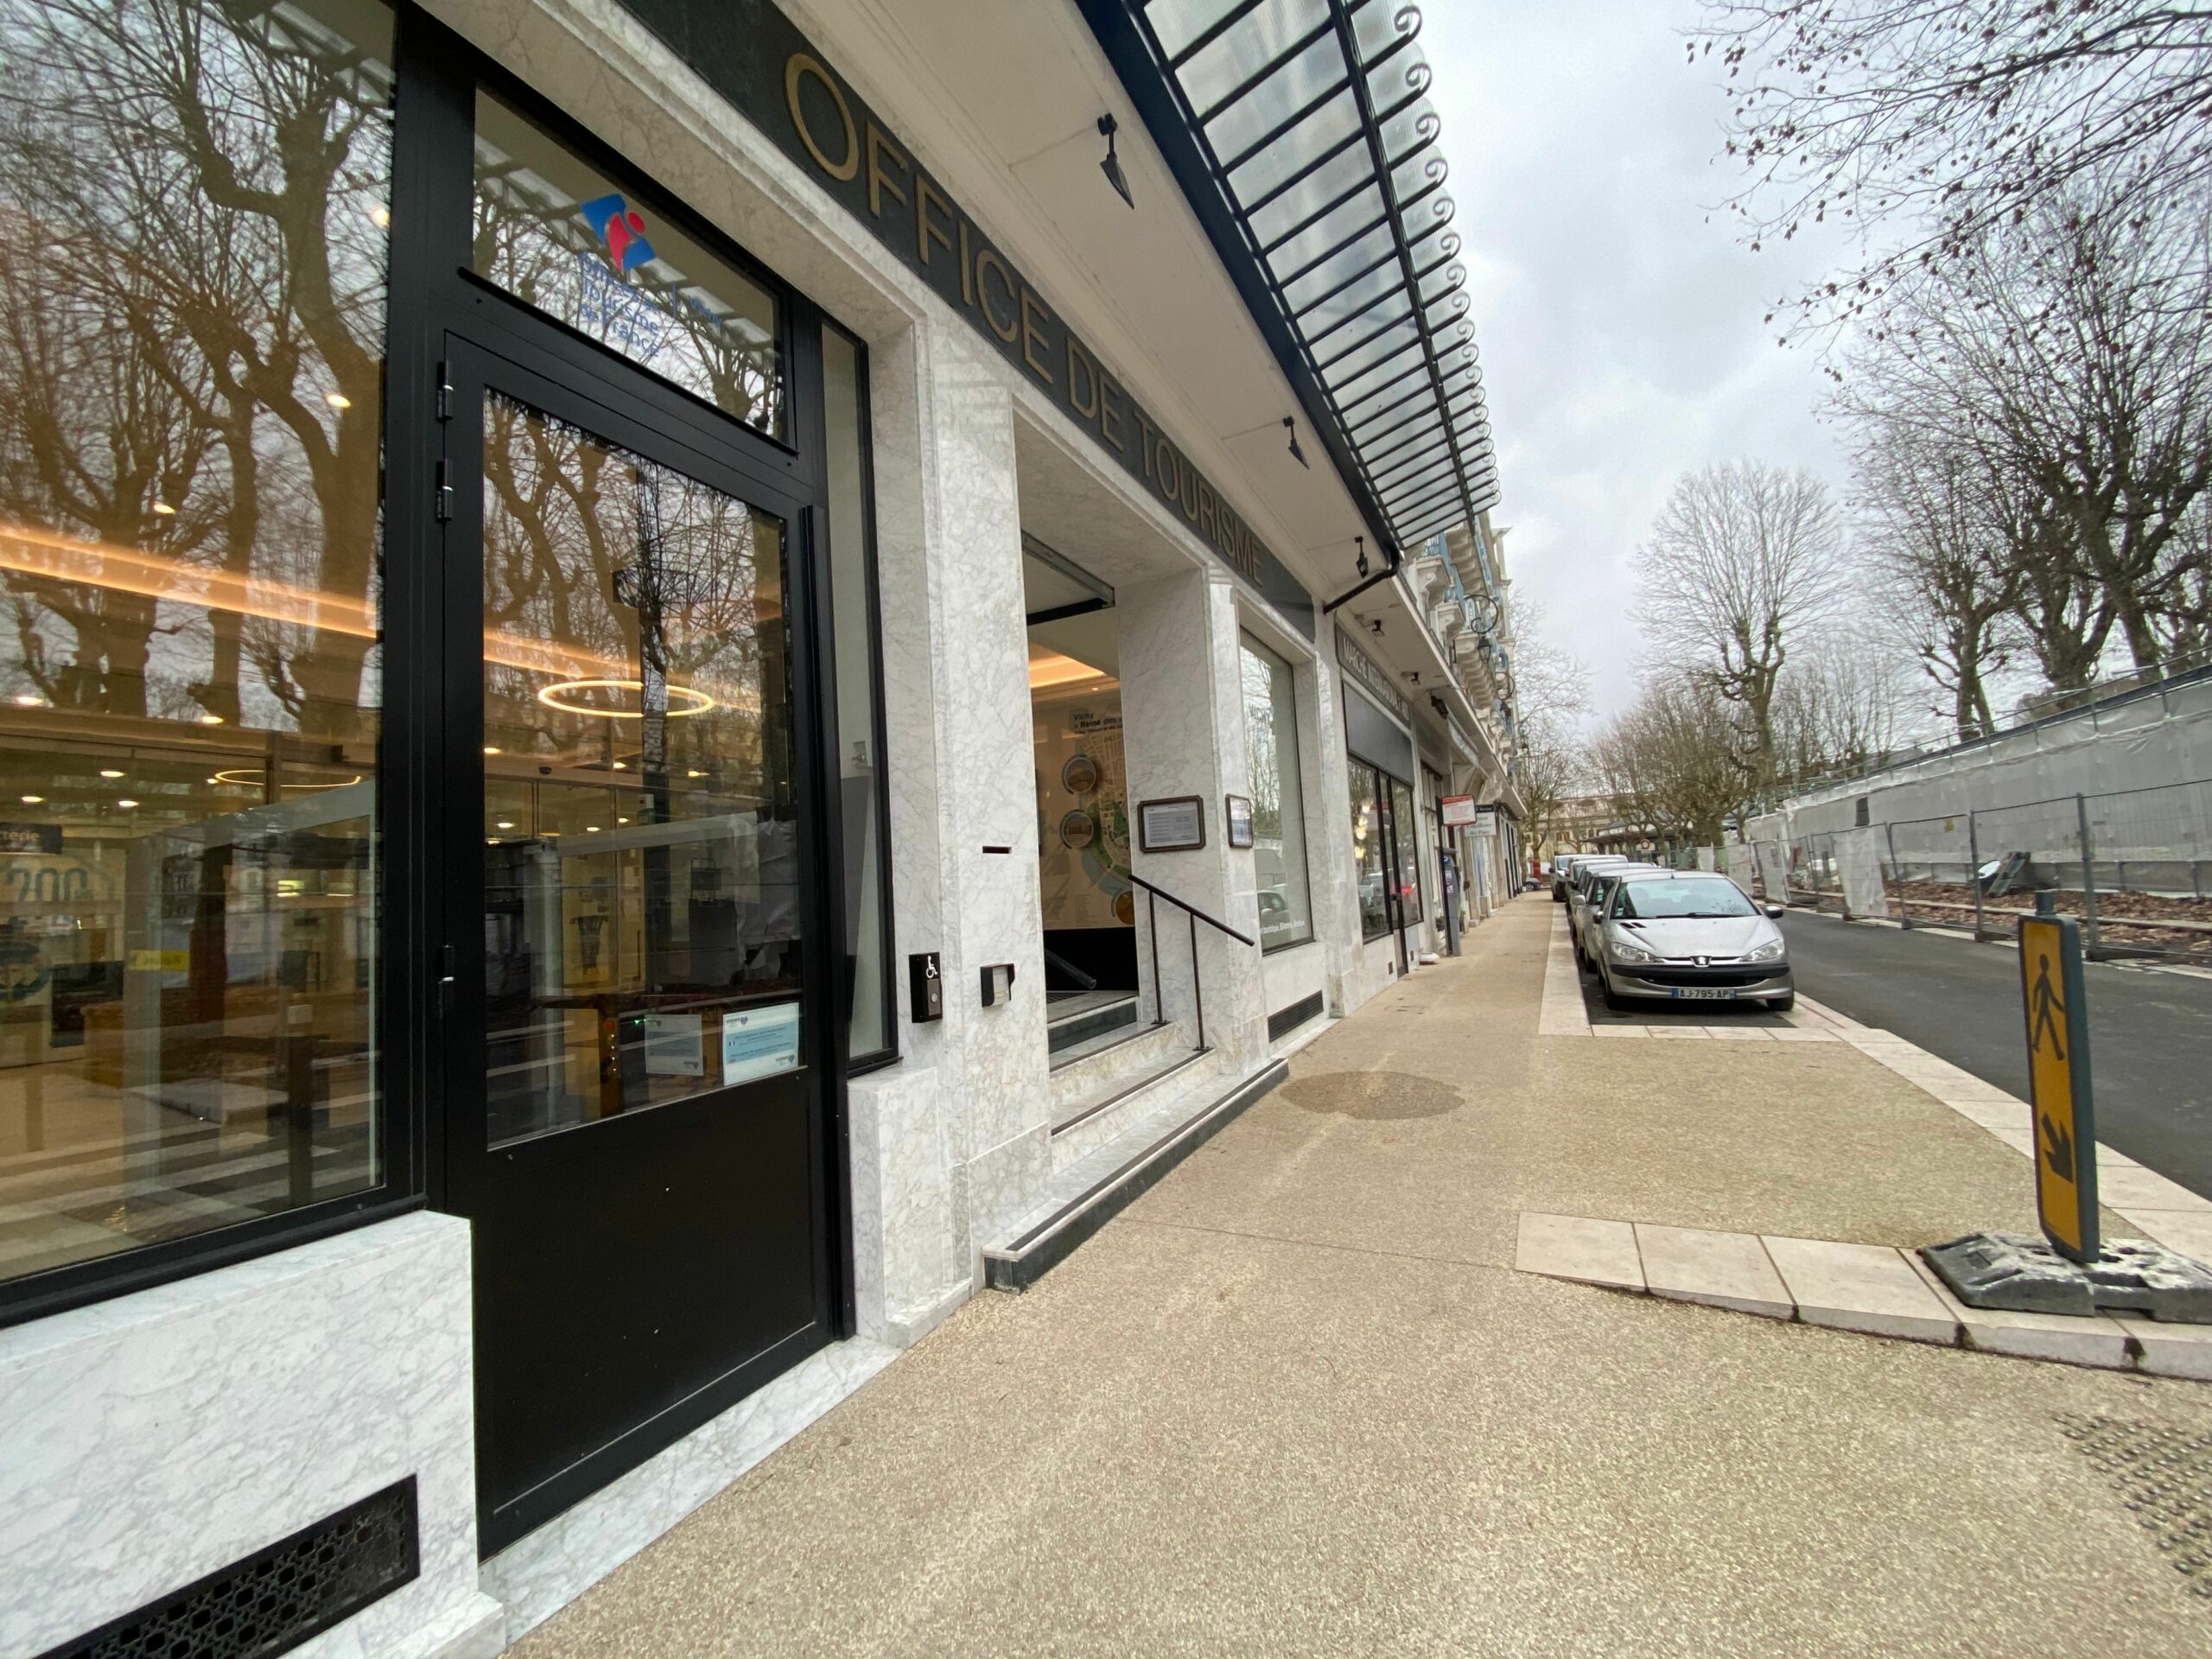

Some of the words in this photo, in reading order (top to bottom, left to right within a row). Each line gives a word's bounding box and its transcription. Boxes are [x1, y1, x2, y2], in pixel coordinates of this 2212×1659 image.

[785, 52, 1053, 384] OFFICE
[1065, 335, 1123, 454] DE
[1132, 408, 1263, 588] TOURISME
[1072, 712, 1094, 721] Vichy
[1680, 989, 1728, 998] AJ-795-AP
